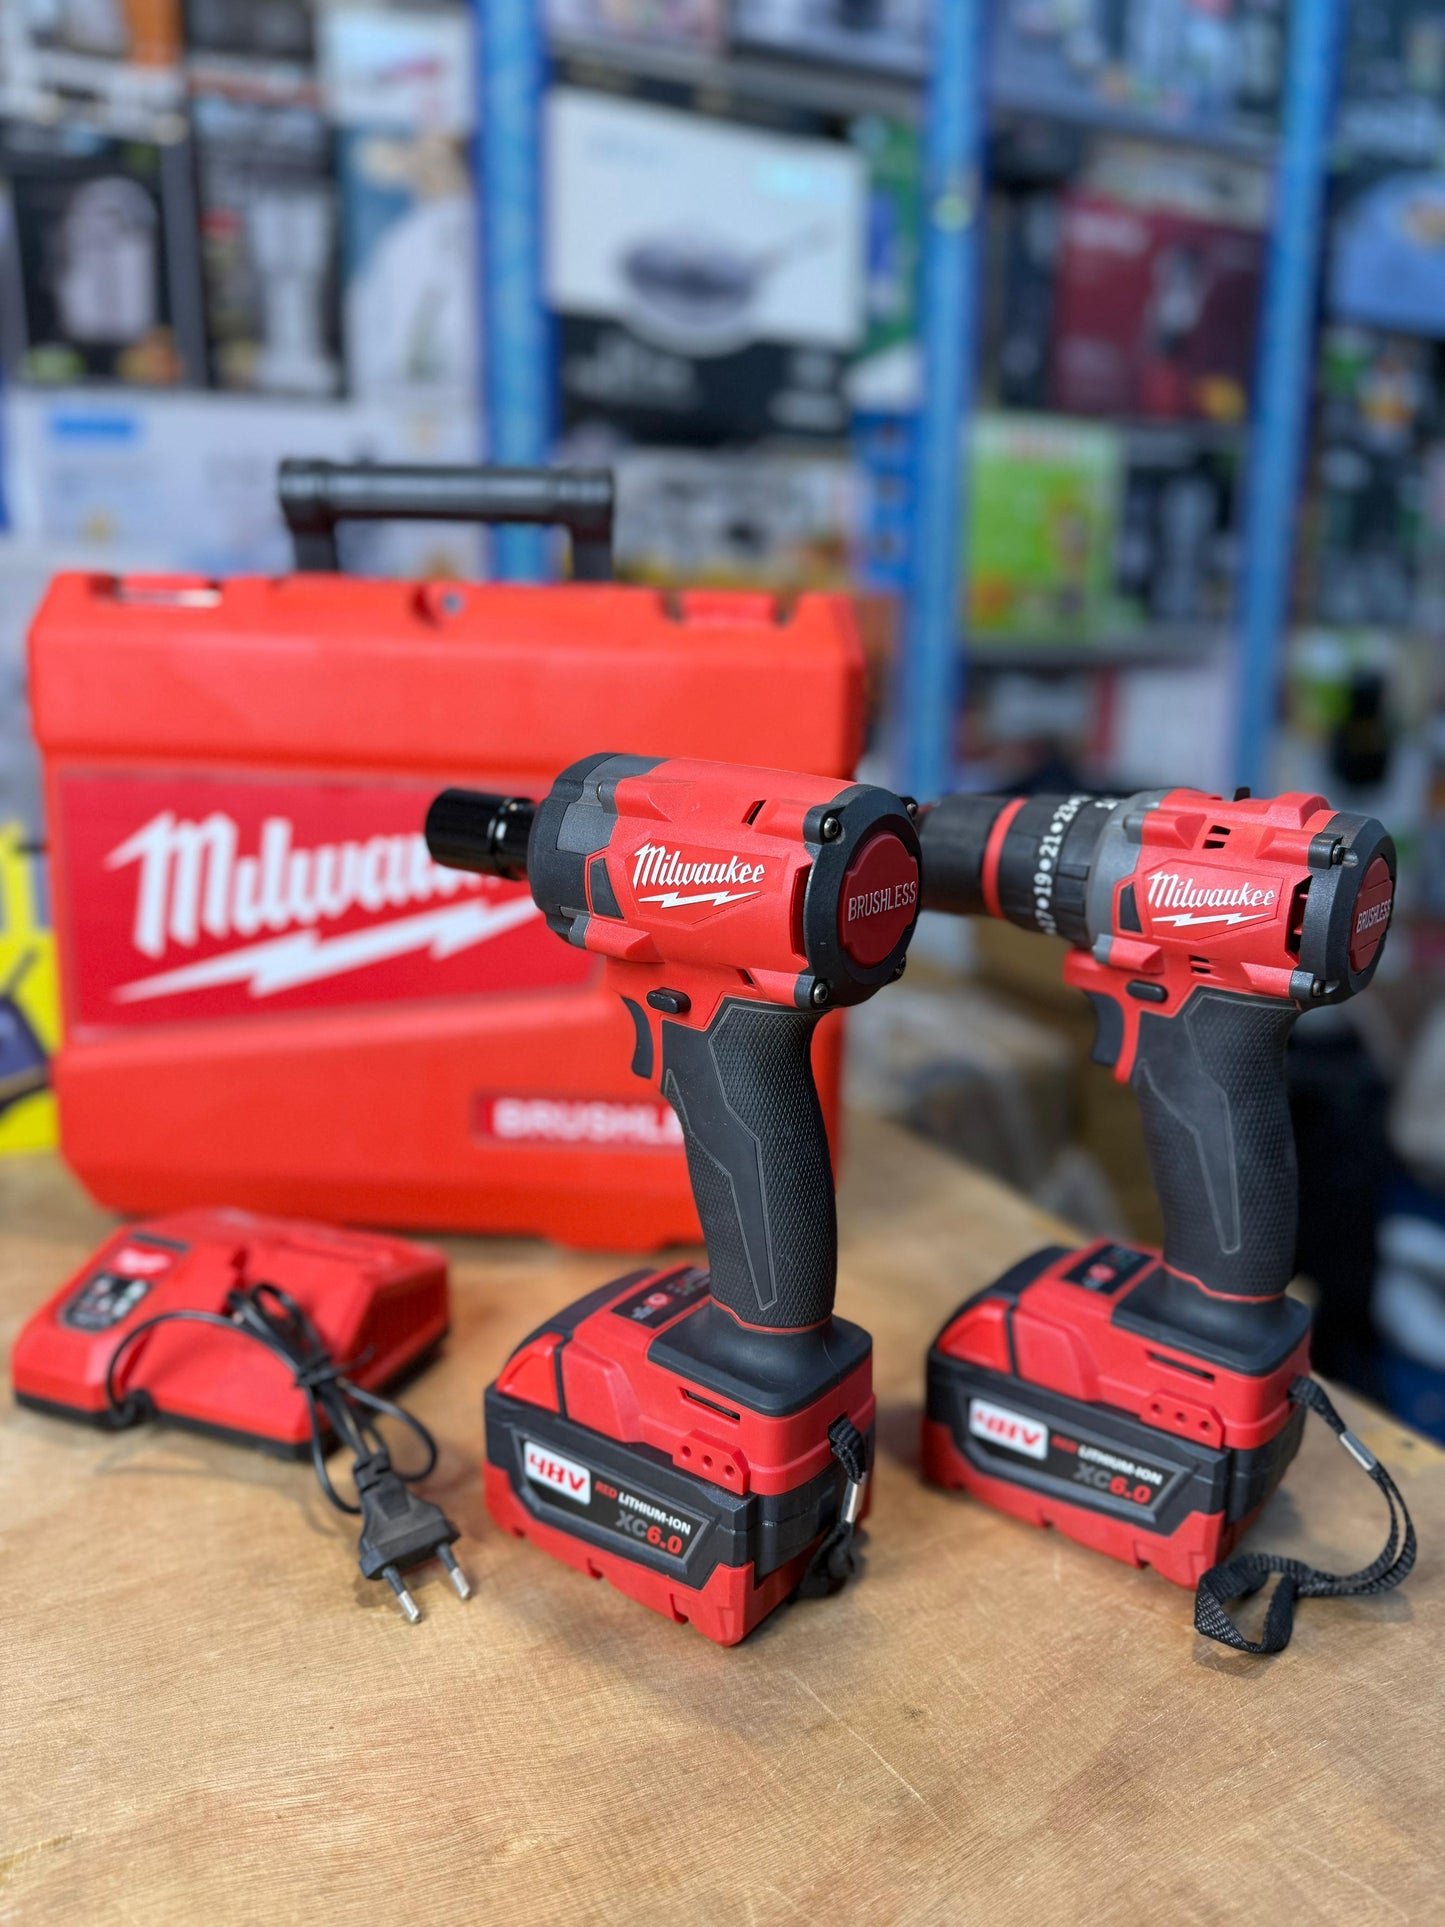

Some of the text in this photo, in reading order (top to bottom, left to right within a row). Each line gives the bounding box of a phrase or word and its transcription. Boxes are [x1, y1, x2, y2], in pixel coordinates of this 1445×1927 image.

[632, 841, 766, 891] Milwaukee
[1039, 834, 1063, 858] 21
[847, 881, 918, 922] BRUSHLESS
[1033, 872, 1053, 898] 19
[1147, 870, 1275, 909] Milwaukee
[1356, 898, 1392, 934] BRUSHLESS
[1073, 1462, 1152, 1505] XC6.0
[615, 1509, 683, 1555] XC6.0
[618, 1491, 692, 1536] LITHIUM-ION
